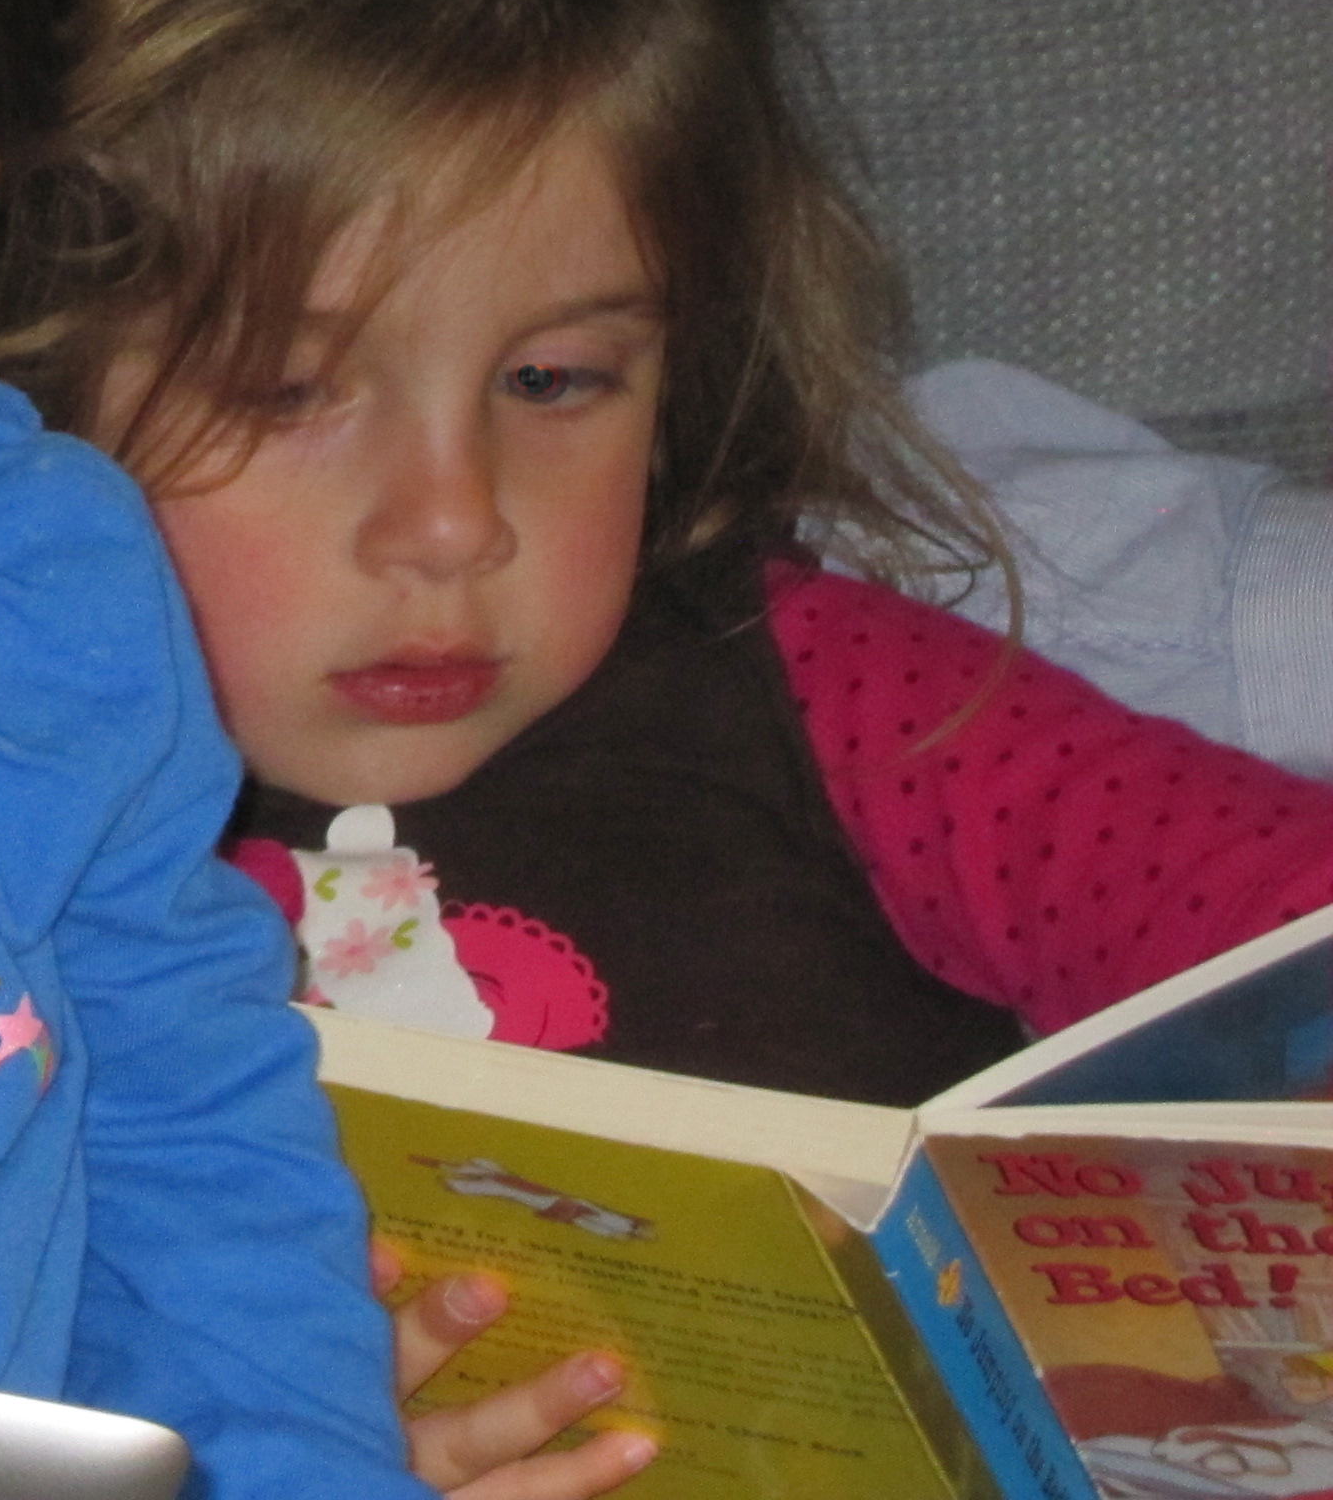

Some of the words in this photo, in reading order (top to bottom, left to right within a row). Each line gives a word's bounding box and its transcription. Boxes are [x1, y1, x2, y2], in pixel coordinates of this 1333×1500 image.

[976, 1153, 1144, 1199] No
[1180, 1158, 1333, 1208] Ju
[1013, 1215, 1157, 1249] on
[1030, 1263, 1300, 1309] Bed!
